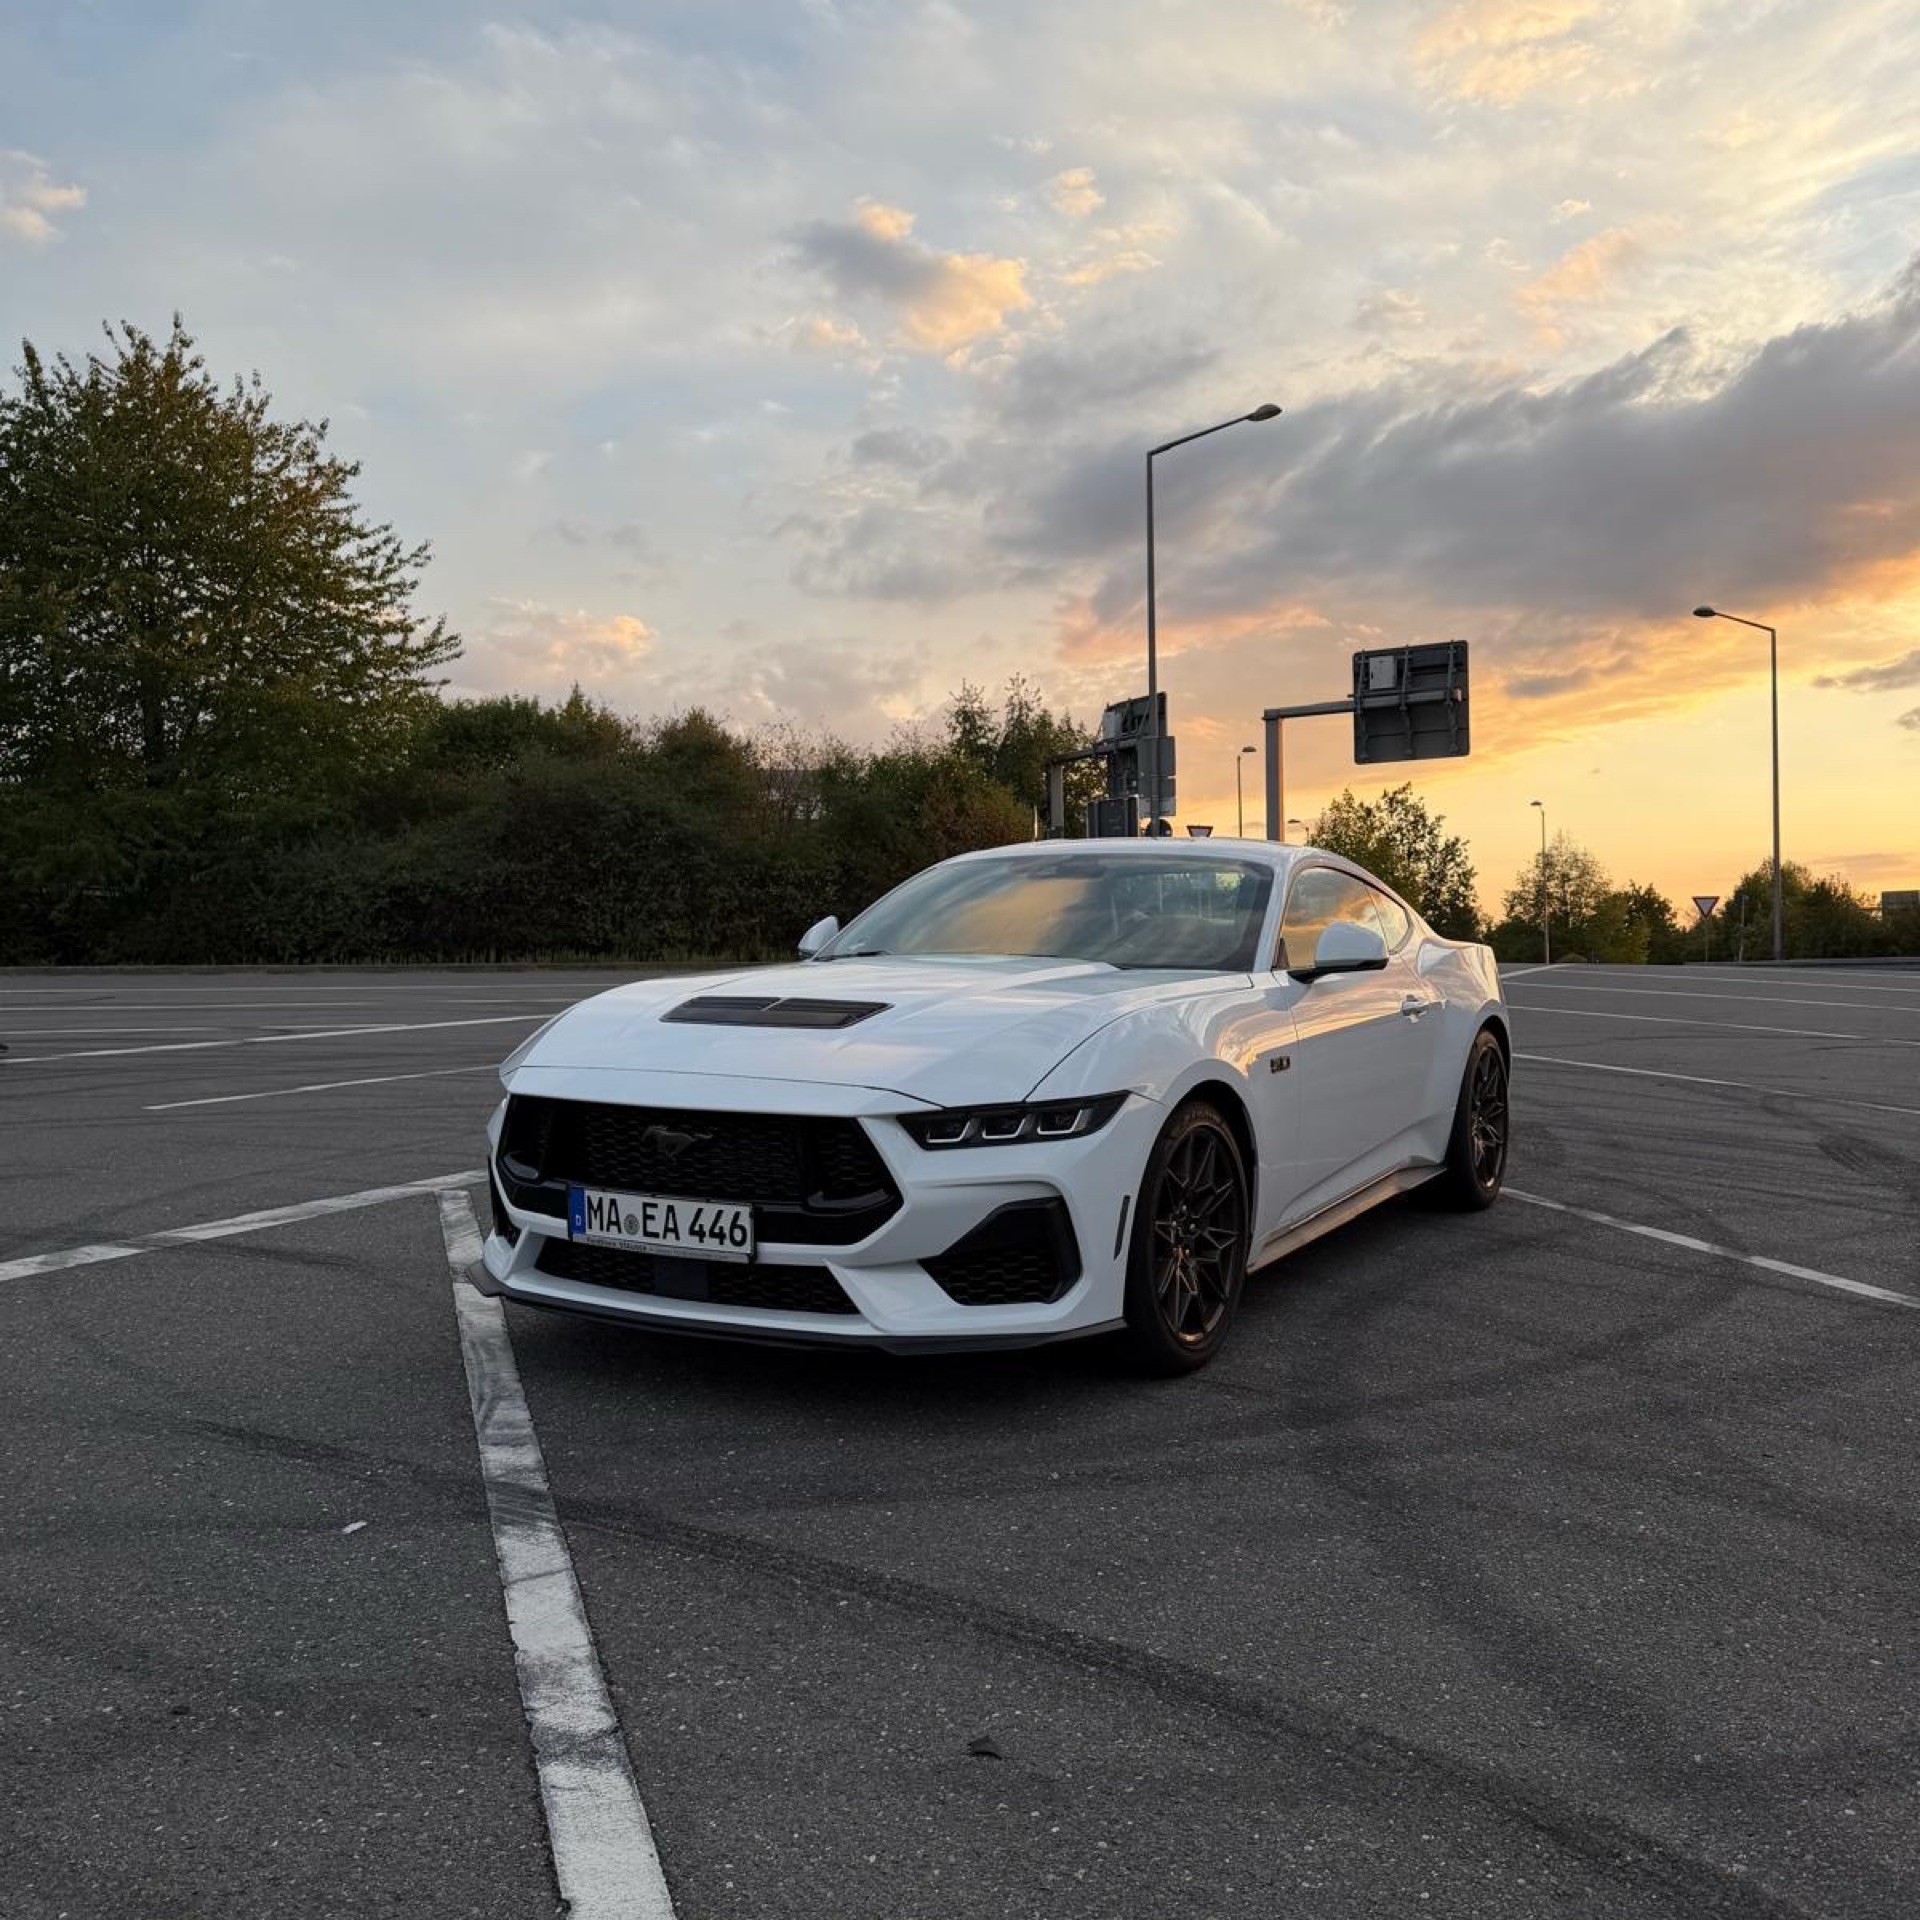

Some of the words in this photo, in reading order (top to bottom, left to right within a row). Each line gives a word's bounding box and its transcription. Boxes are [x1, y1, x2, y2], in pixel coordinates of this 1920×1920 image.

[575, 1214, 582, 1226] D
[587, 1195, 622, 1234] MA
[642, 1202, 680, 1241] EA
[688, 1207, 748, 1247] 446
